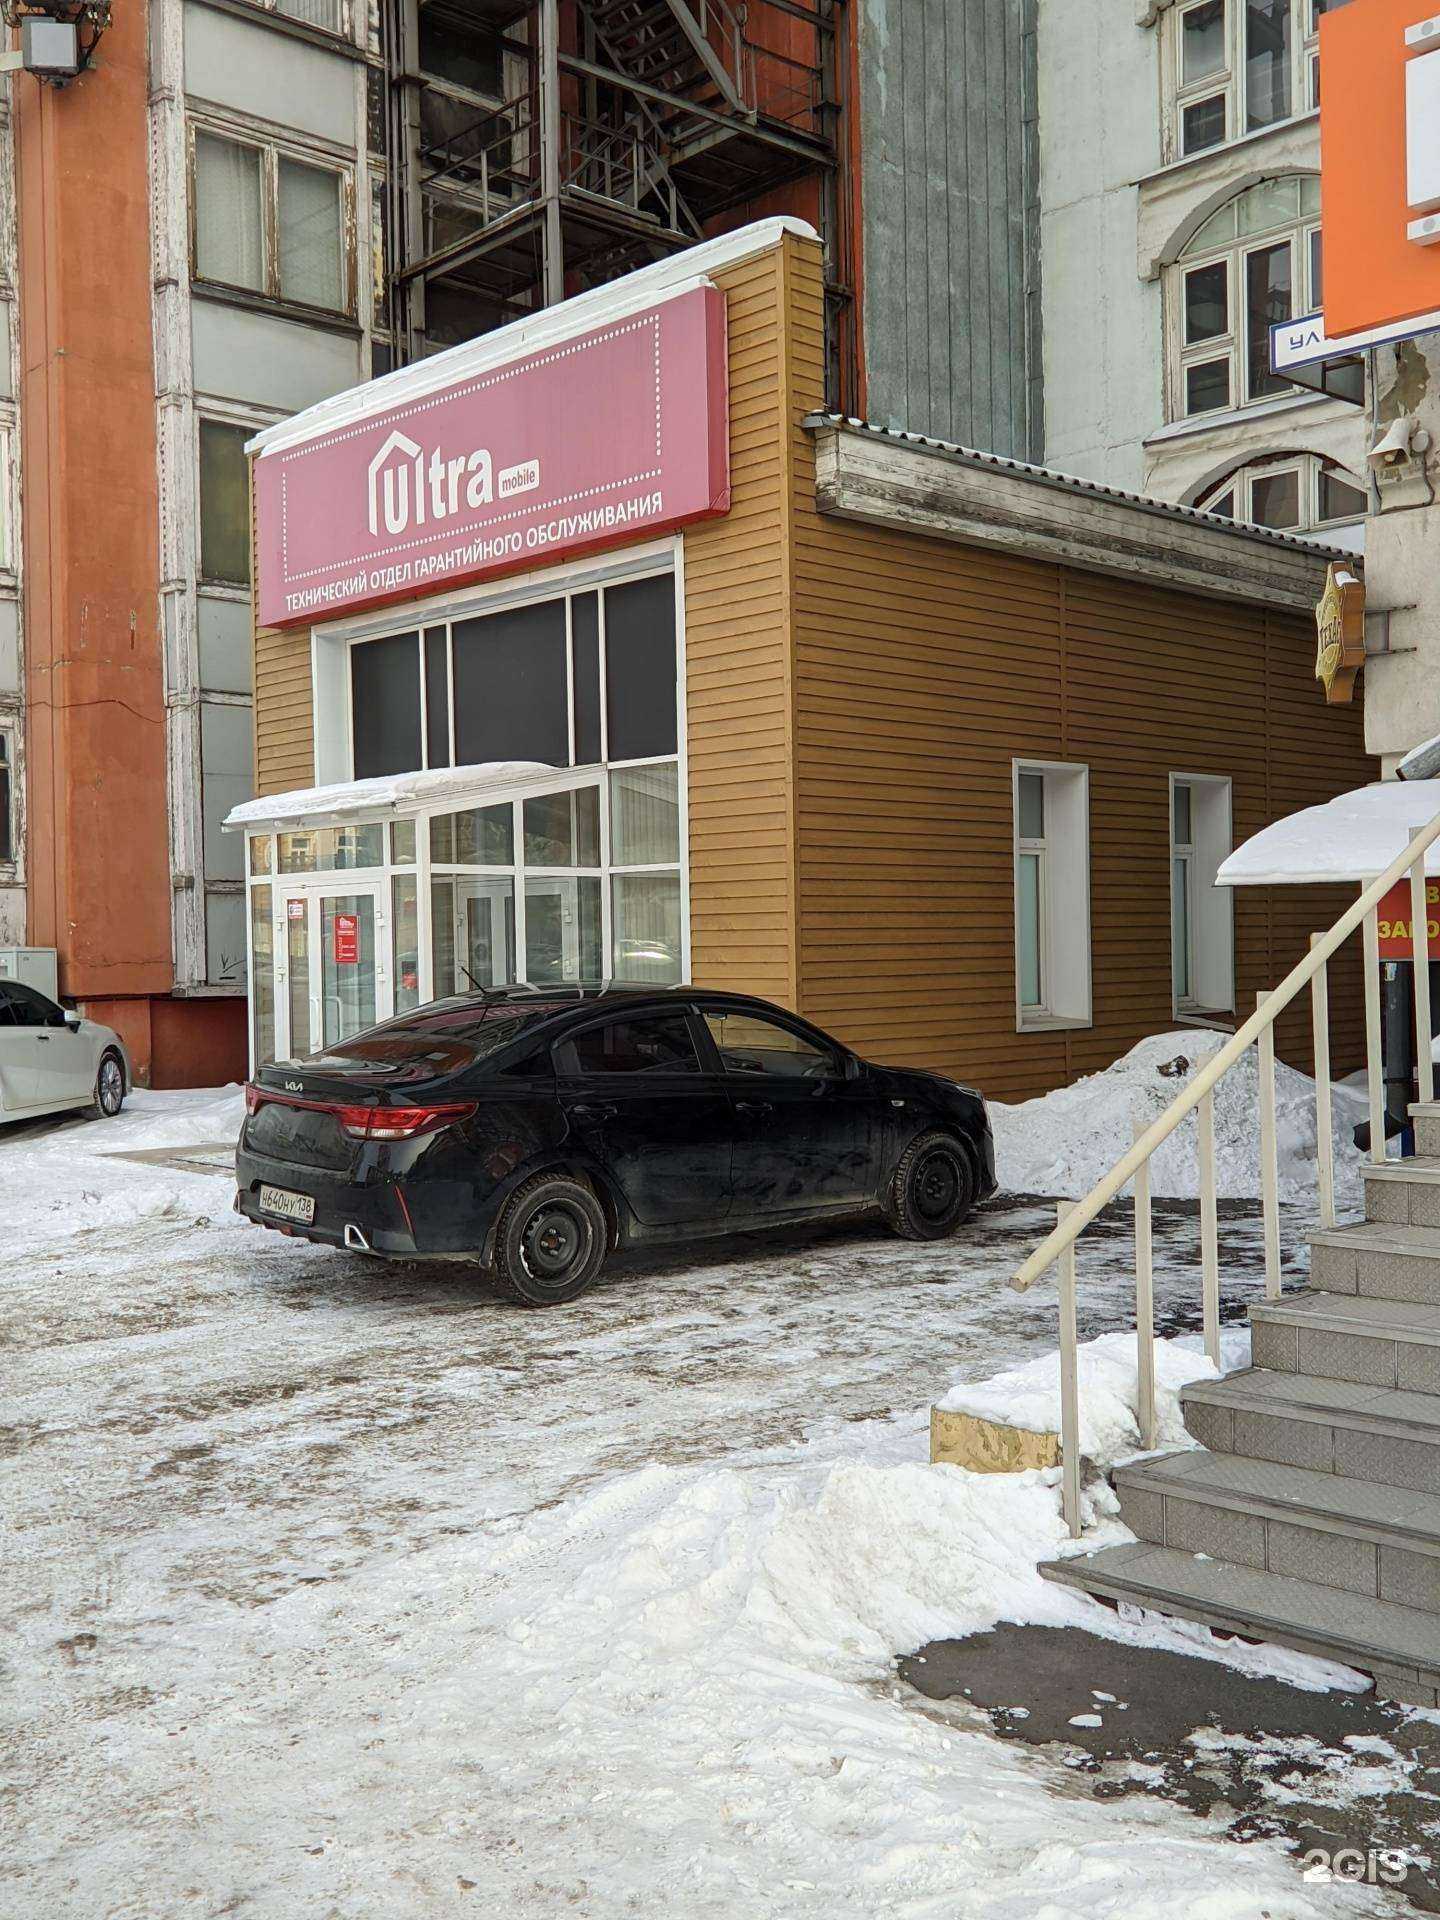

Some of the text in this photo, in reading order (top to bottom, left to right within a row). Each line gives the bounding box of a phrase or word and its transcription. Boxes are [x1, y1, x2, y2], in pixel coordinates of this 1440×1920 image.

[502, 468, 536, 492] mobile
[285, 491, 663, 612] ТЕХНИЧЕСКИЙ ОТДЕЛ ГАРАНТИЙНОГО ОБСЛУЖИВАНИЯ
